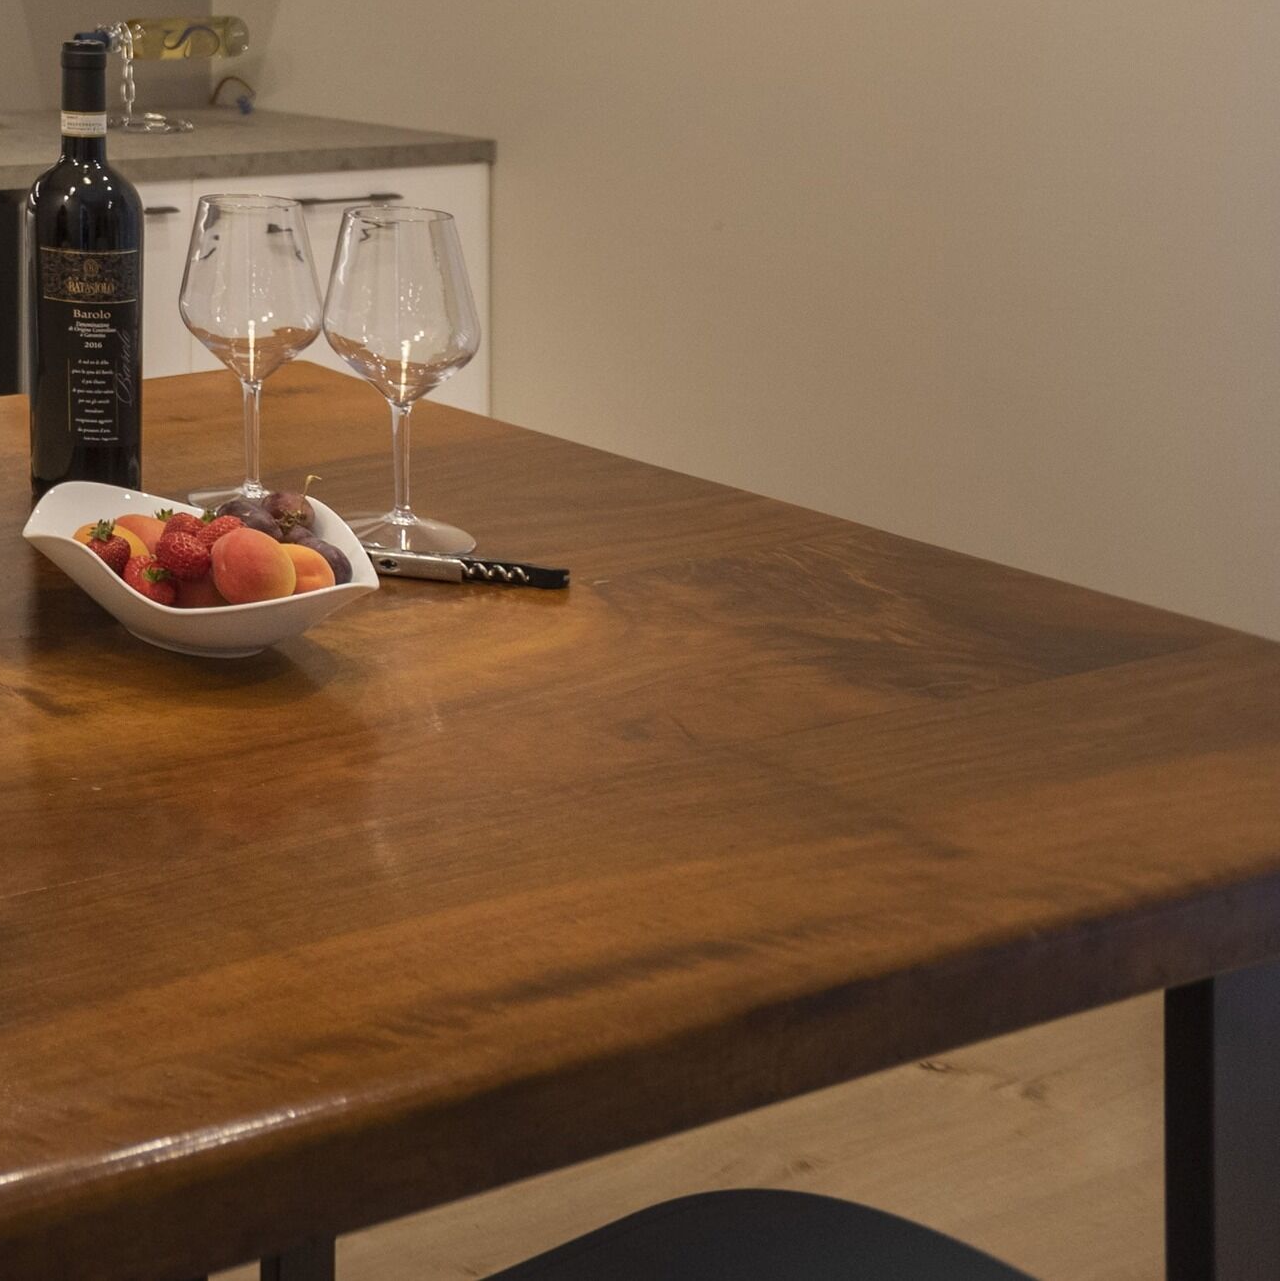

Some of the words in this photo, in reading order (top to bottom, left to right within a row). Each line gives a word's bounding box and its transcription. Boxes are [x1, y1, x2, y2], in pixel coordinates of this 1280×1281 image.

[68, 280, 116, 295] BATASIOLO
[73, 309, 112, 319] Barolo
[84, 341, 103, 349] 2016
